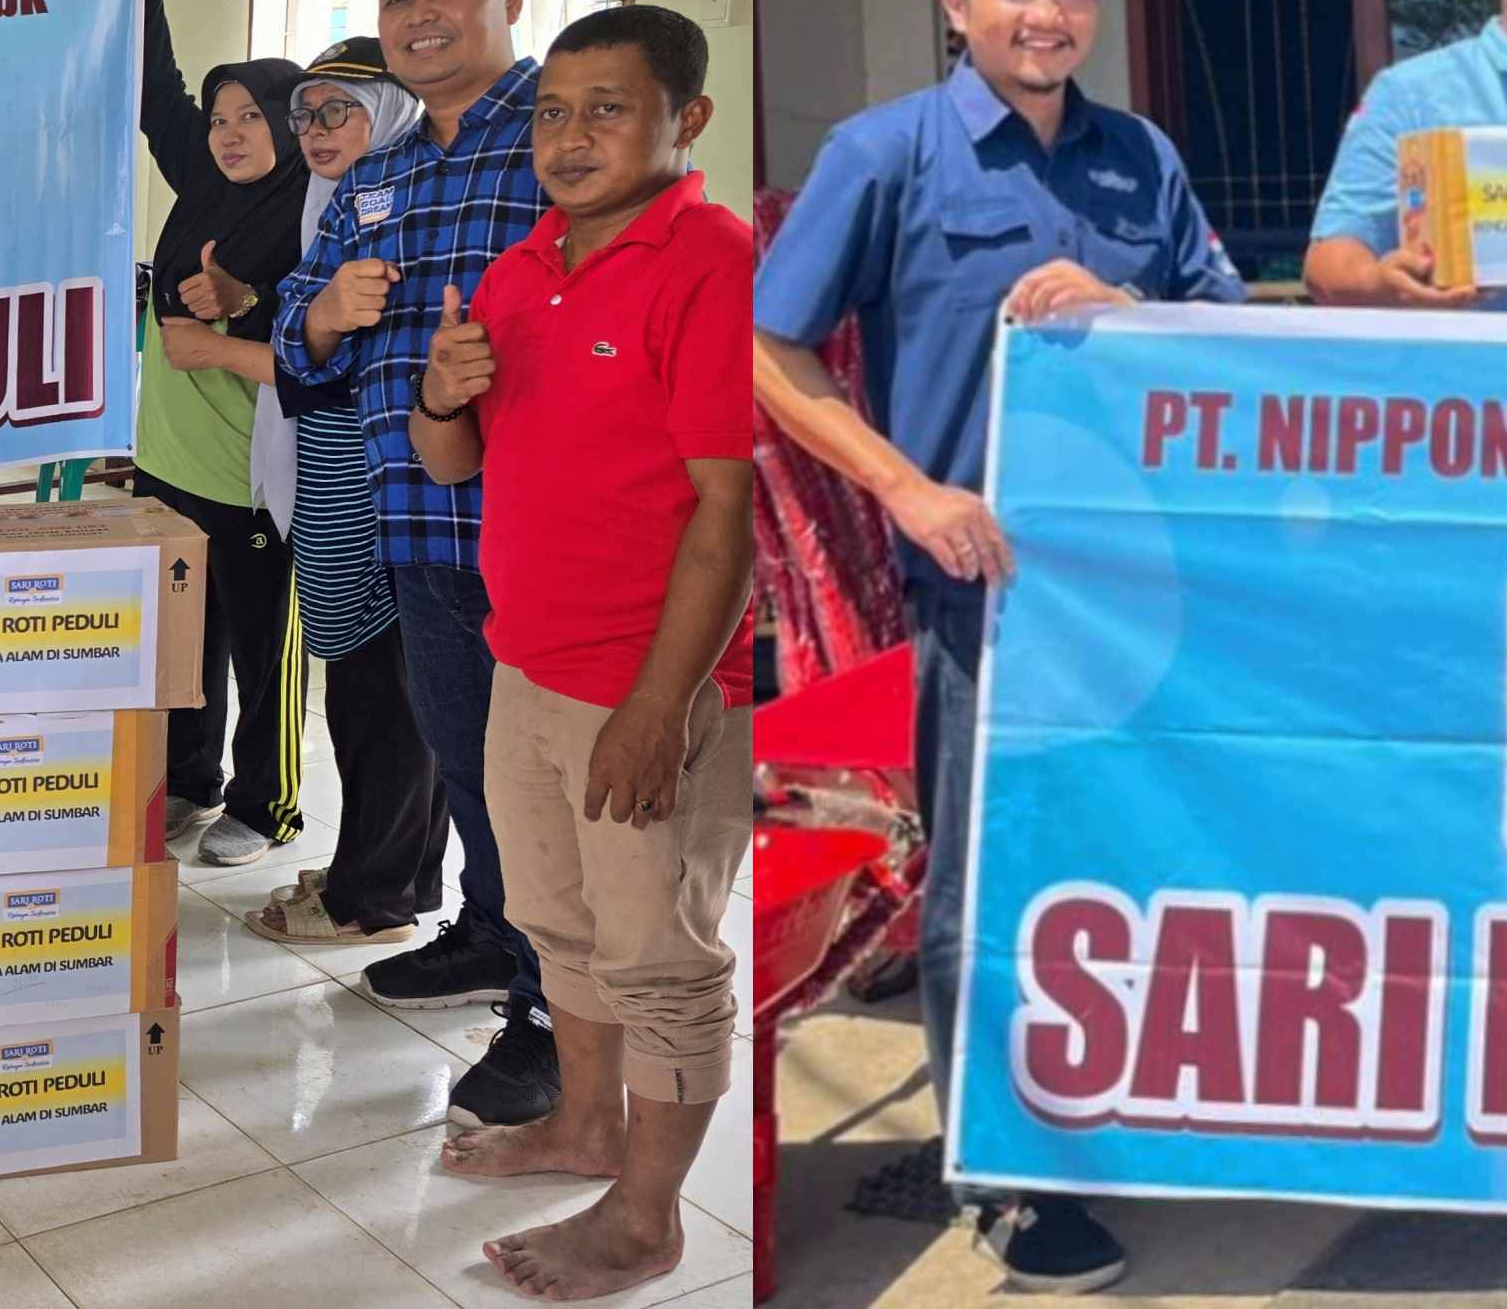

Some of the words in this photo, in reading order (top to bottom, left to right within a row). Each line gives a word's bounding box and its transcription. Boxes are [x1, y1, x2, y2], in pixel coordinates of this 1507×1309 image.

[1143, 391, 1237, 477] PT.
[172, 582, 188, 592] UP
[2, 615, 46, 633] ROTI
[52, 612, 118, 631] PEDULI
[5, 649, 43, 662] ALAM
[46, 648, 60, 660] DI
[62, 646, 120, 659] SUMBAR
[1018, 889, 1442, 1126] SARI
[147, 1045, 164, 1055] UP
[43, 1070, 105, 1093] PEDULI
[1, 1110, 36, 1125] ALAM
[39, 1108, 52, 1120] DI
[54, 1102, 107, 1118] SUMBAR
